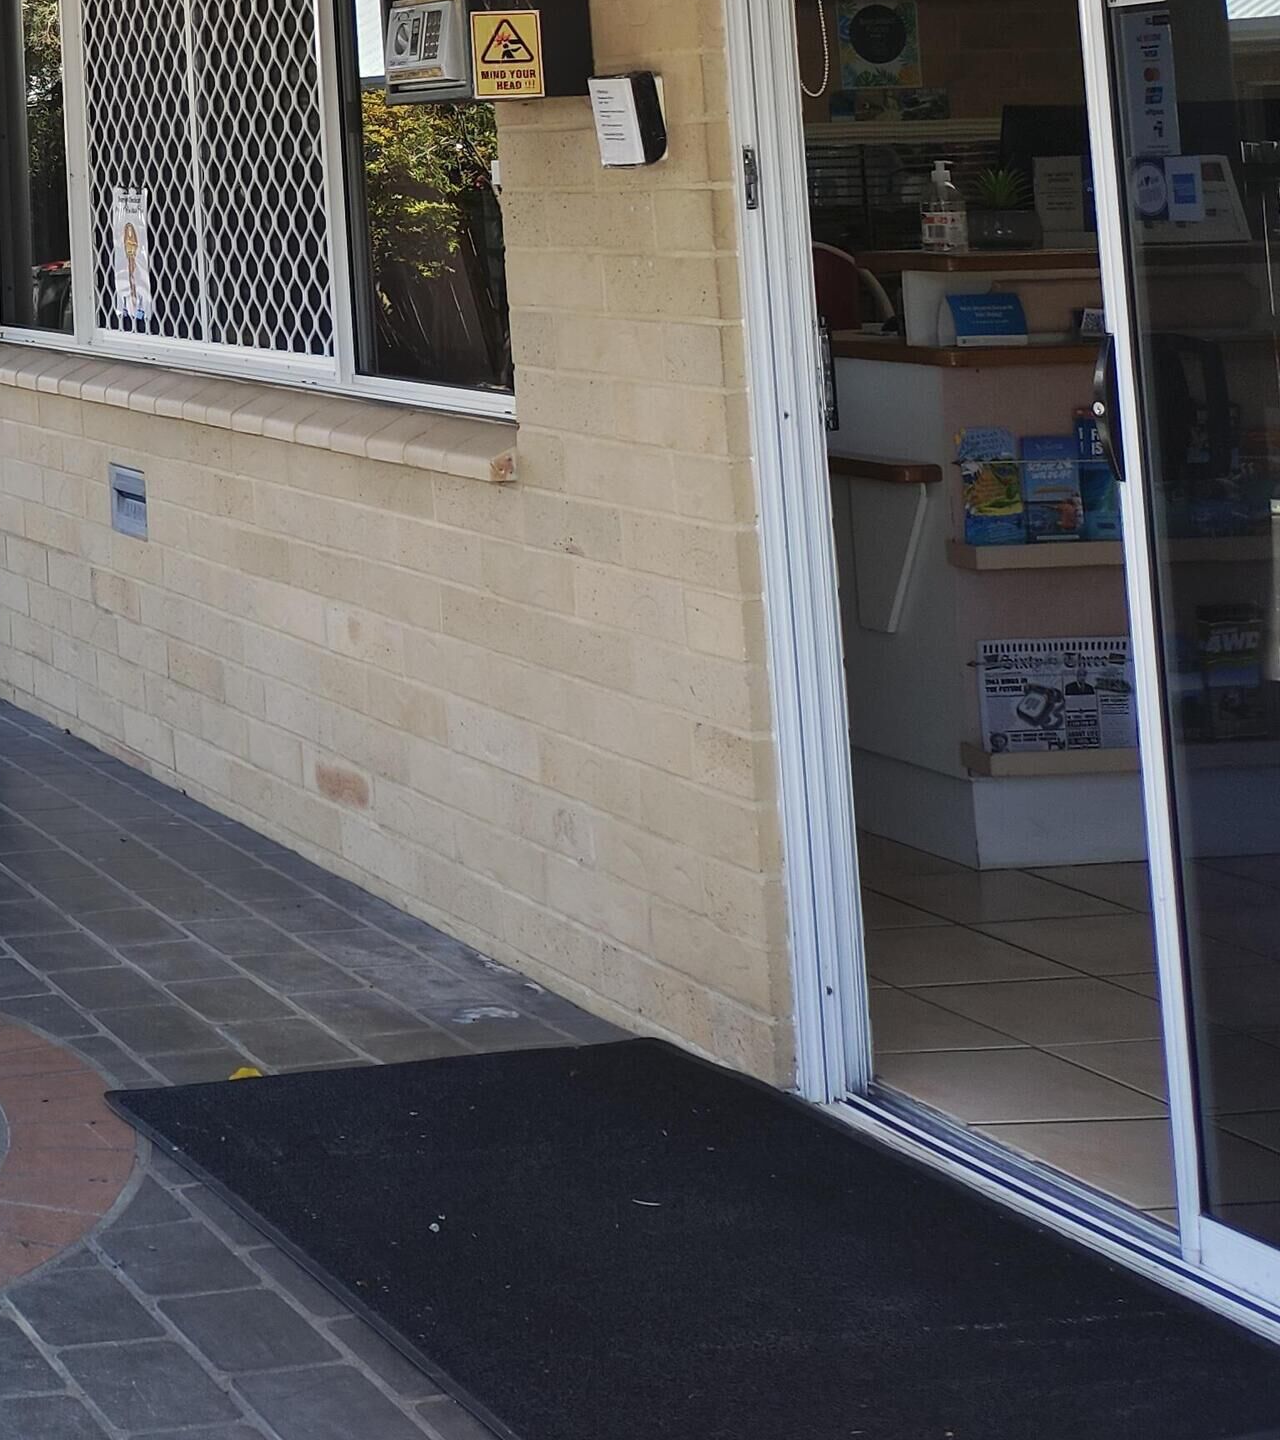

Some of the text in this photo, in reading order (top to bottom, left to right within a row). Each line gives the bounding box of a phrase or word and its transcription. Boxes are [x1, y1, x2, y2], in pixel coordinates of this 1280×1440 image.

[481, 69, 537, 80] MIND YOUR
[496, 80, 522, 90] HEAD
[1063, 652, 1109, 670] Three
